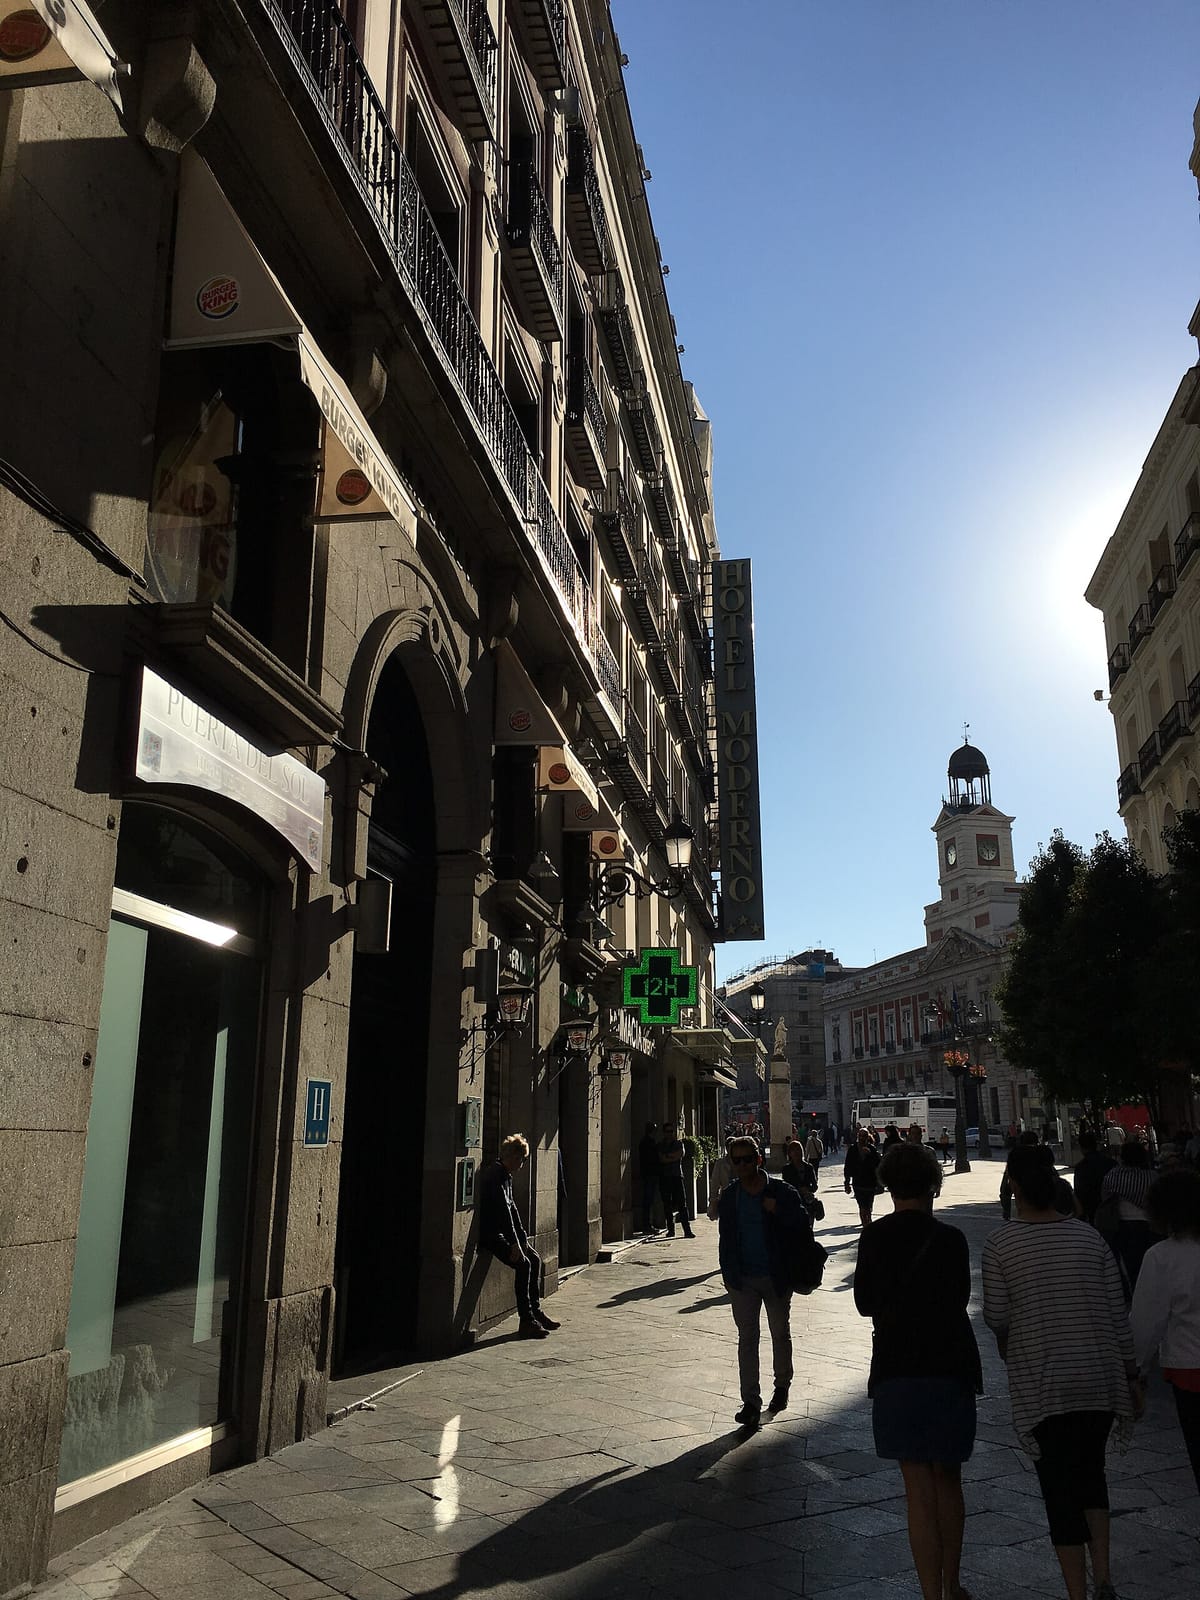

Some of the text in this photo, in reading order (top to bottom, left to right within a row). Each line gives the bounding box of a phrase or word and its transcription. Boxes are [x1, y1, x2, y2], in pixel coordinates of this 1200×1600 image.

[202, 281, 236, 301] BURGER
[202, 289, 238, 311] KING
[321, 385, 371, 474] BURGER
[372, 462, 400, 517] KING
[167, 686, 241, 761] PUERTA
[247, 743, 277, 785] DEL
[281, 764, 309, 806] SOL
[719, 561, 756, 903] HOTEL MODERNO
[643, 977, 678, 996] 12H
[312, 1087, 326, 1121] H
